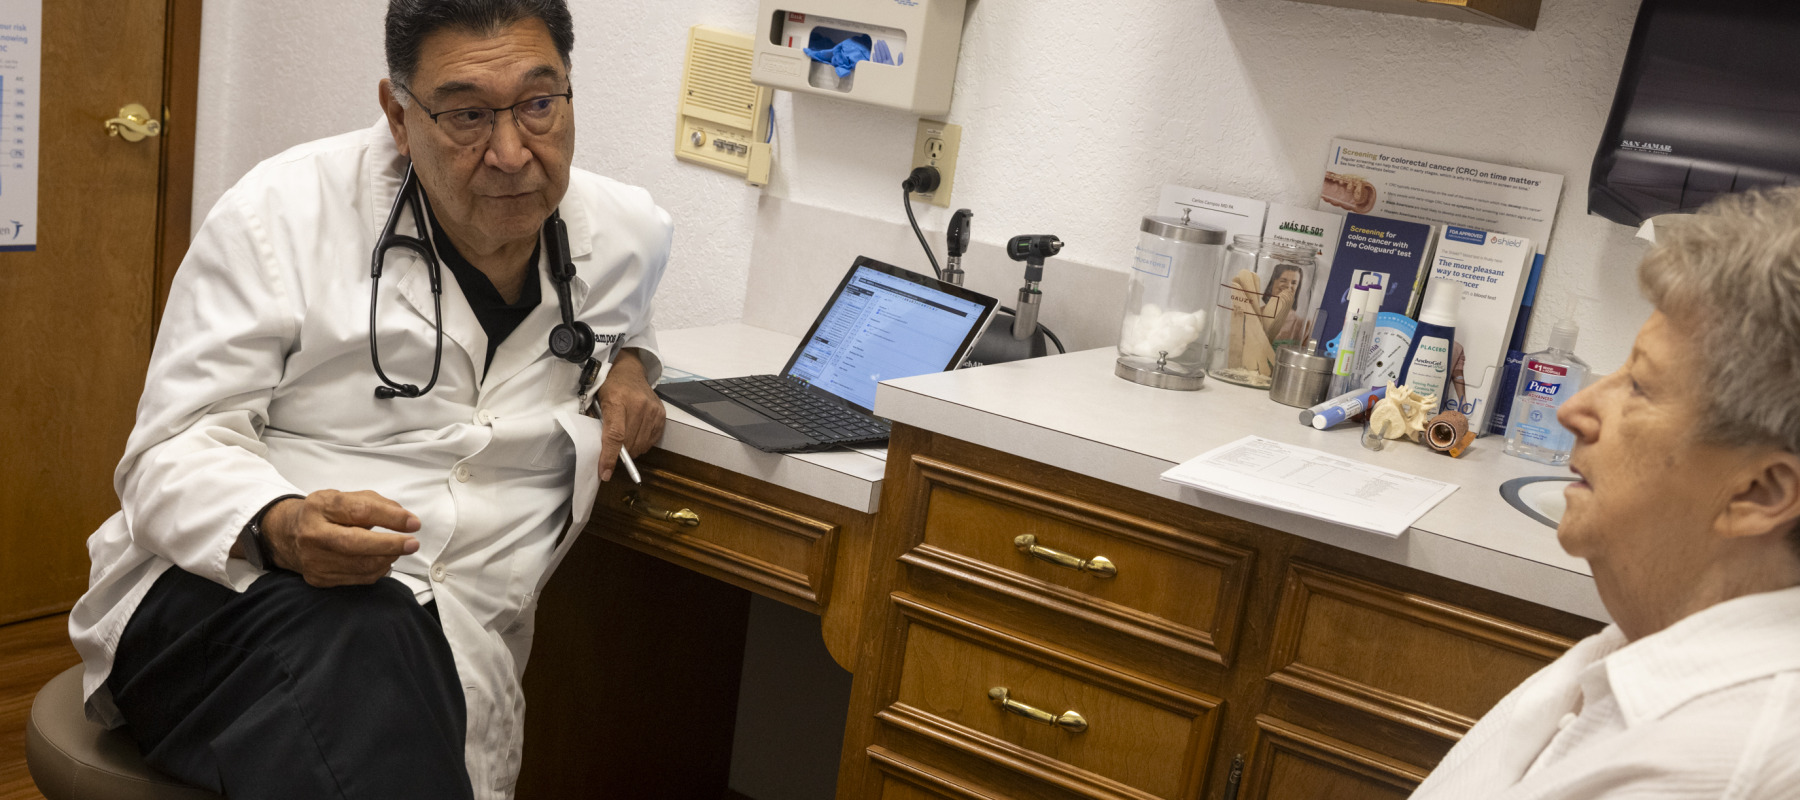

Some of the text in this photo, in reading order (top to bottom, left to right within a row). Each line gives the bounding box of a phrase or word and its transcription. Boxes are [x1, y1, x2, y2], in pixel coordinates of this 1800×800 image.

[1342, 148, 1378, 160] Screening
[1391, 156, 1427, 168] colorectal
[1429, 164, 1454, 172] cancer
[1456, 166, 1478, 177] (CRC)
[1491, 173, 1507, 181] time
[1279, 221, 1324, 236] ¿MÁS DE 50?
[1350, 225, 1384, 238] Screening
[1368, 237, 1391, 246] cancer
[1397, 249, 1411, 257] test
[1439, 259, 1452, 267] The
[1473, 266, 1504, 276] pleasant
[1437, 268, 1452, 276] way
[1461, 272, 1485, 281] screen
[595, 333, 616, 345] ampos
[1420, 344, 1446, 352] PLACEBO
[1529, 381, 1557, 394] Purell
